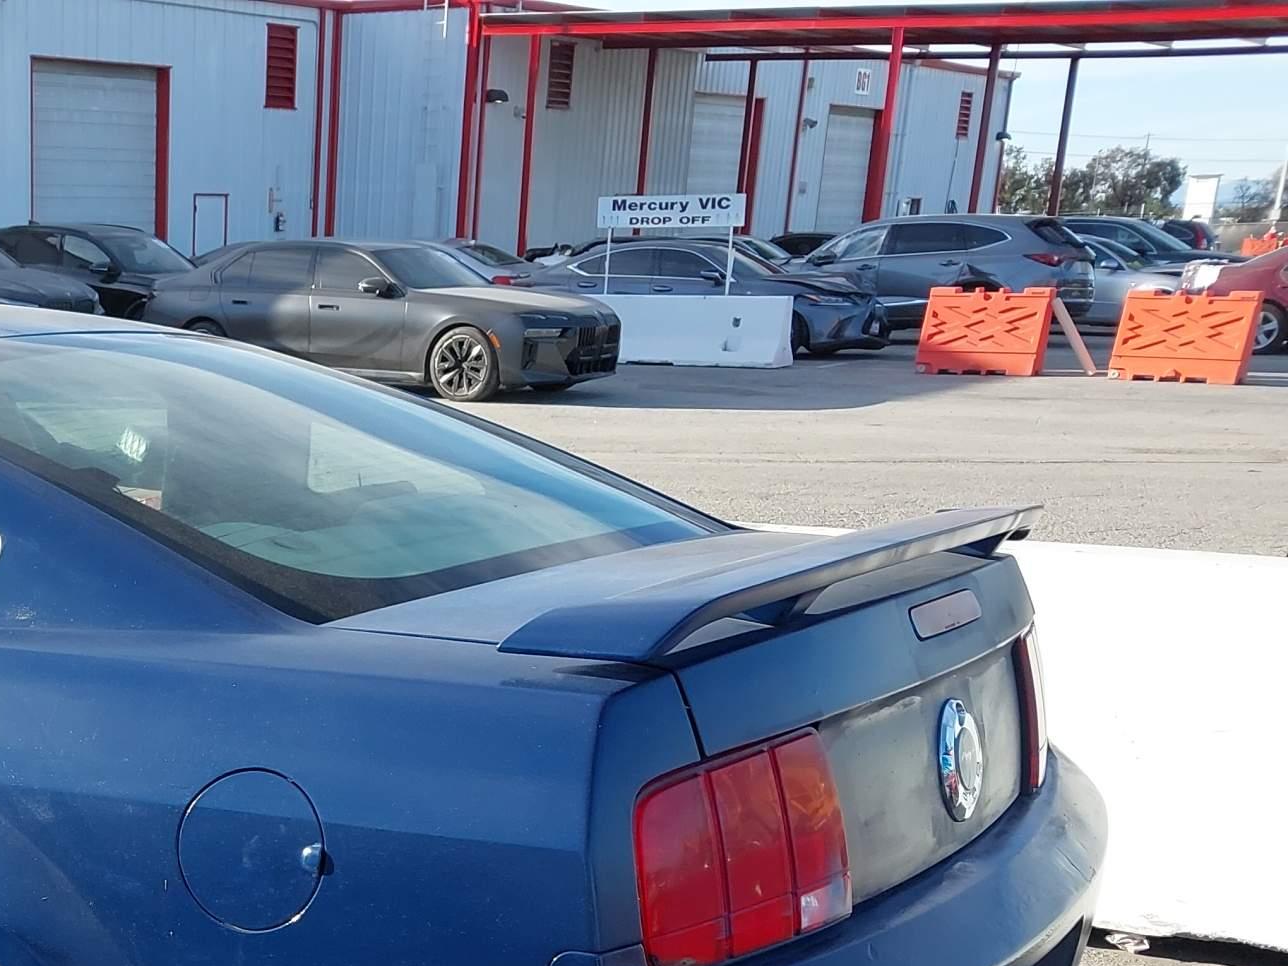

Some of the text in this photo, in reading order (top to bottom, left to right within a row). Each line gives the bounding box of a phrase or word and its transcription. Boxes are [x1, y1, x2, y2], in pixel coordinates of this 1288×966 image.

[612, 197, 731, 213] Mercury VIC
[629, 215, 712, 225] DROP OFF
